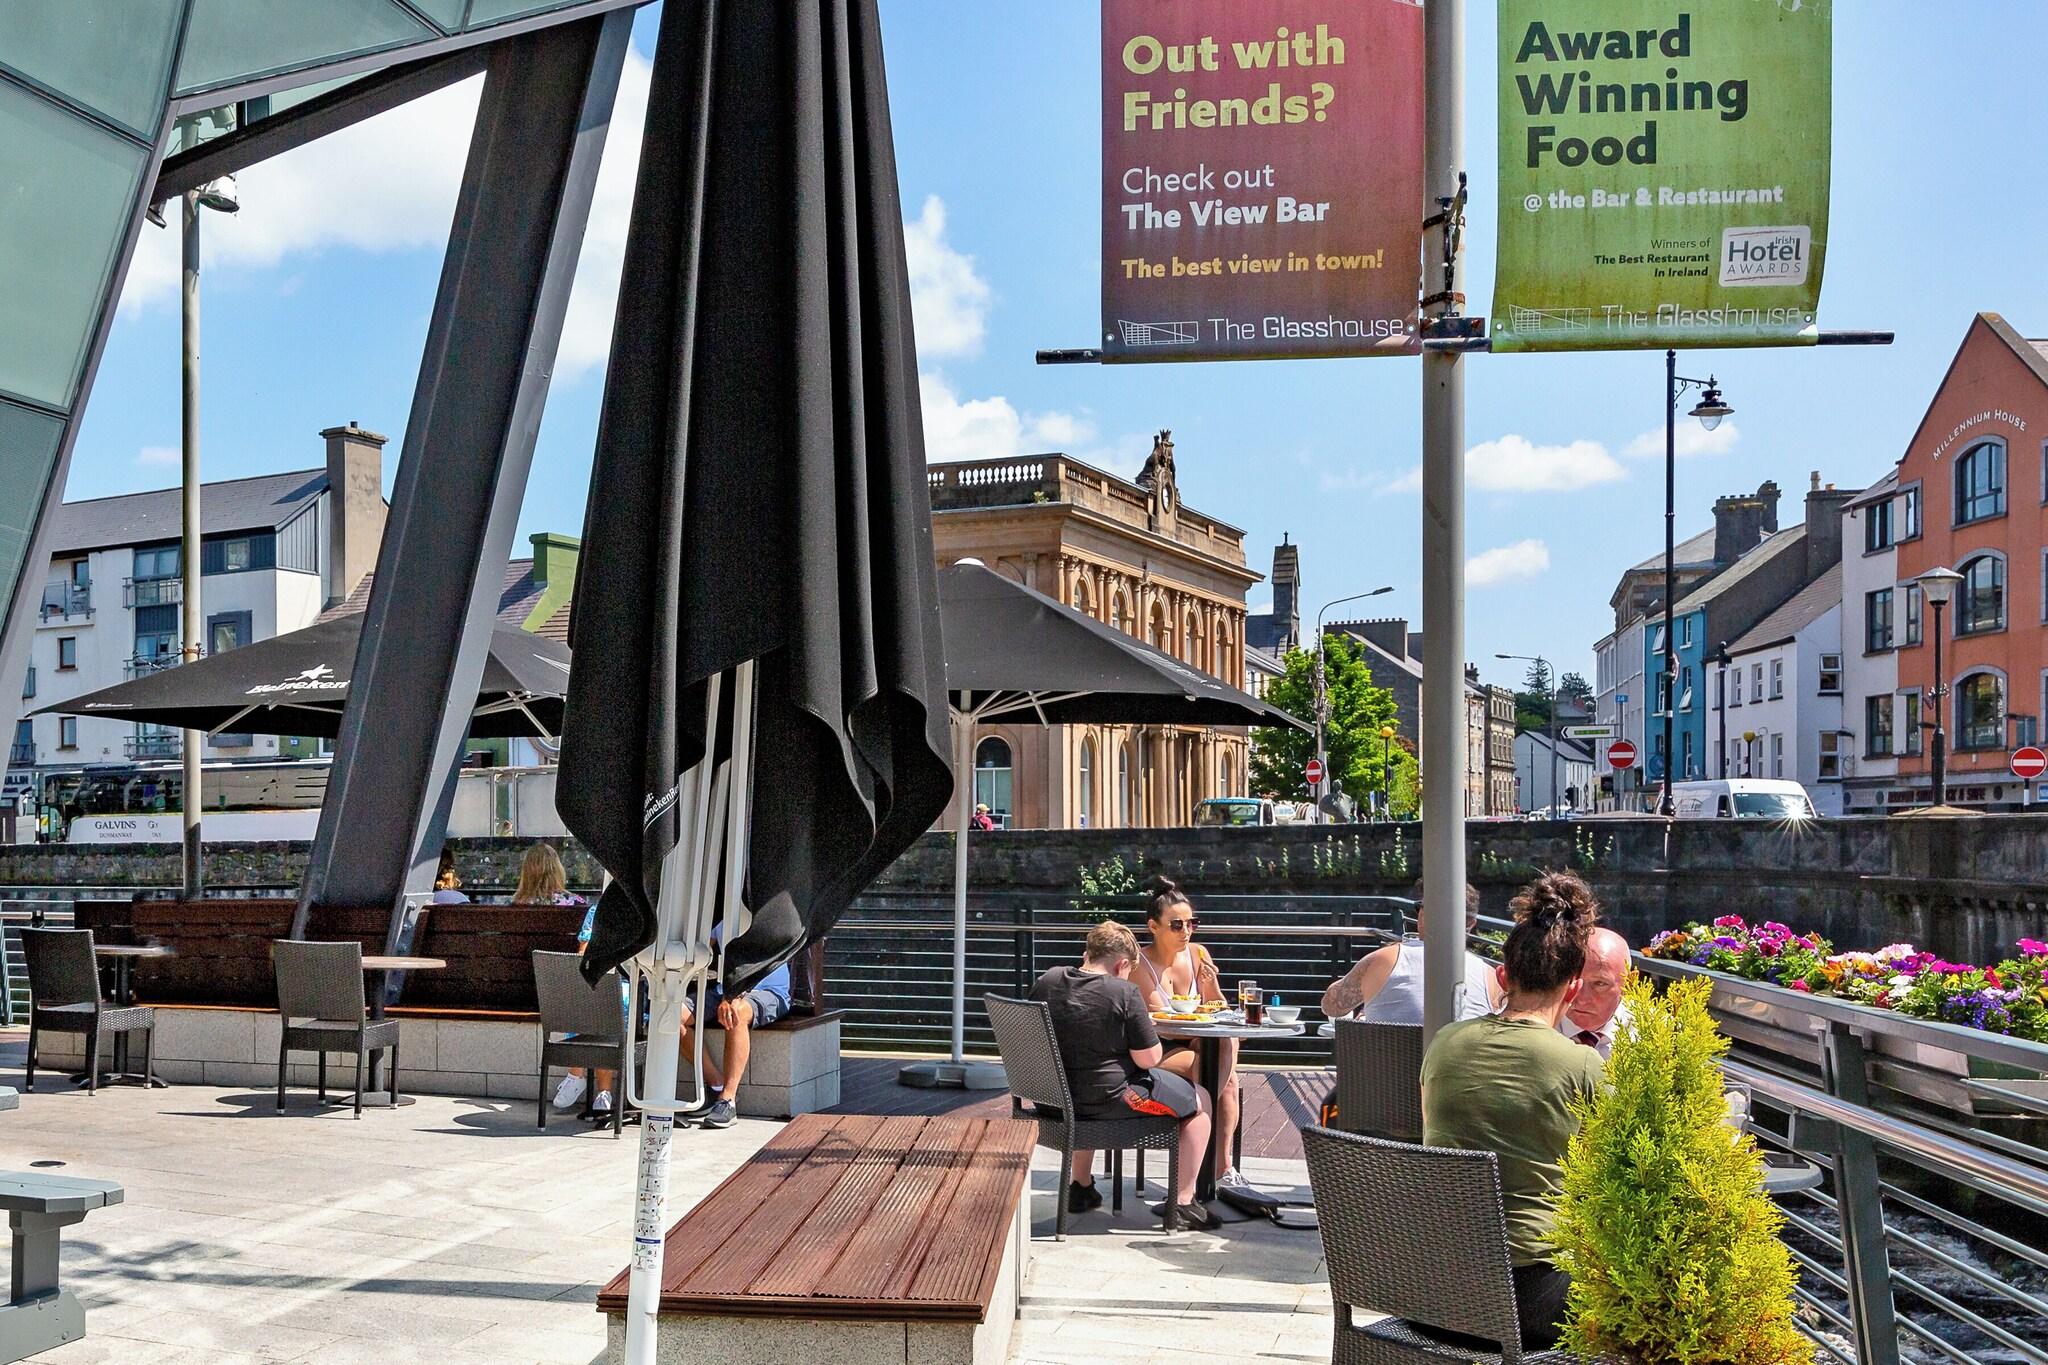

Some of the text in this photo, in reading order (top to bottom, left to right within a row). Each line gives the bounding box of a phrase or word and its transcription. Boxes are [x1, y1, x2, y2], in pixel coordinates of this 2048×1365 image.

[1122, 24, 1345, 74] Out with
[1515, 13, 1691, 63] Award
[1124, 83, 1334, 131] Friends?
[1515, 67, 1749, 122] Winning
[1526, 120, 1657, 168] Food
[1122, 163, 1274, 194] Check out
[1523, 185, 1783, 212] @ the Bar & Restaurant
[1121, 197, 1330, 230] The View Bar
[1651, 237, 1711, 250] Winners of
[1729, 238, 1801, 262] Hotel
[1775, 236, 1795, 245] Irish
[1121, 249, 1384, 279] The best view in town!
[1595, 253, 1710, 265] The Best Restaurant
[1654, 266, 1708, 278] In Ireland
[1727, 263, 1801, 275] AWARDS
[1208, 315, 1404, 340] The Glasshouse
[1601, 302, 1801, 329] The Glasshouse
[1933, 409, 2026, 460] MILLENNIUM HOUSE
[245, 680, 350, 694] Heineken
[95, 820, 136, 830] GALVINS
